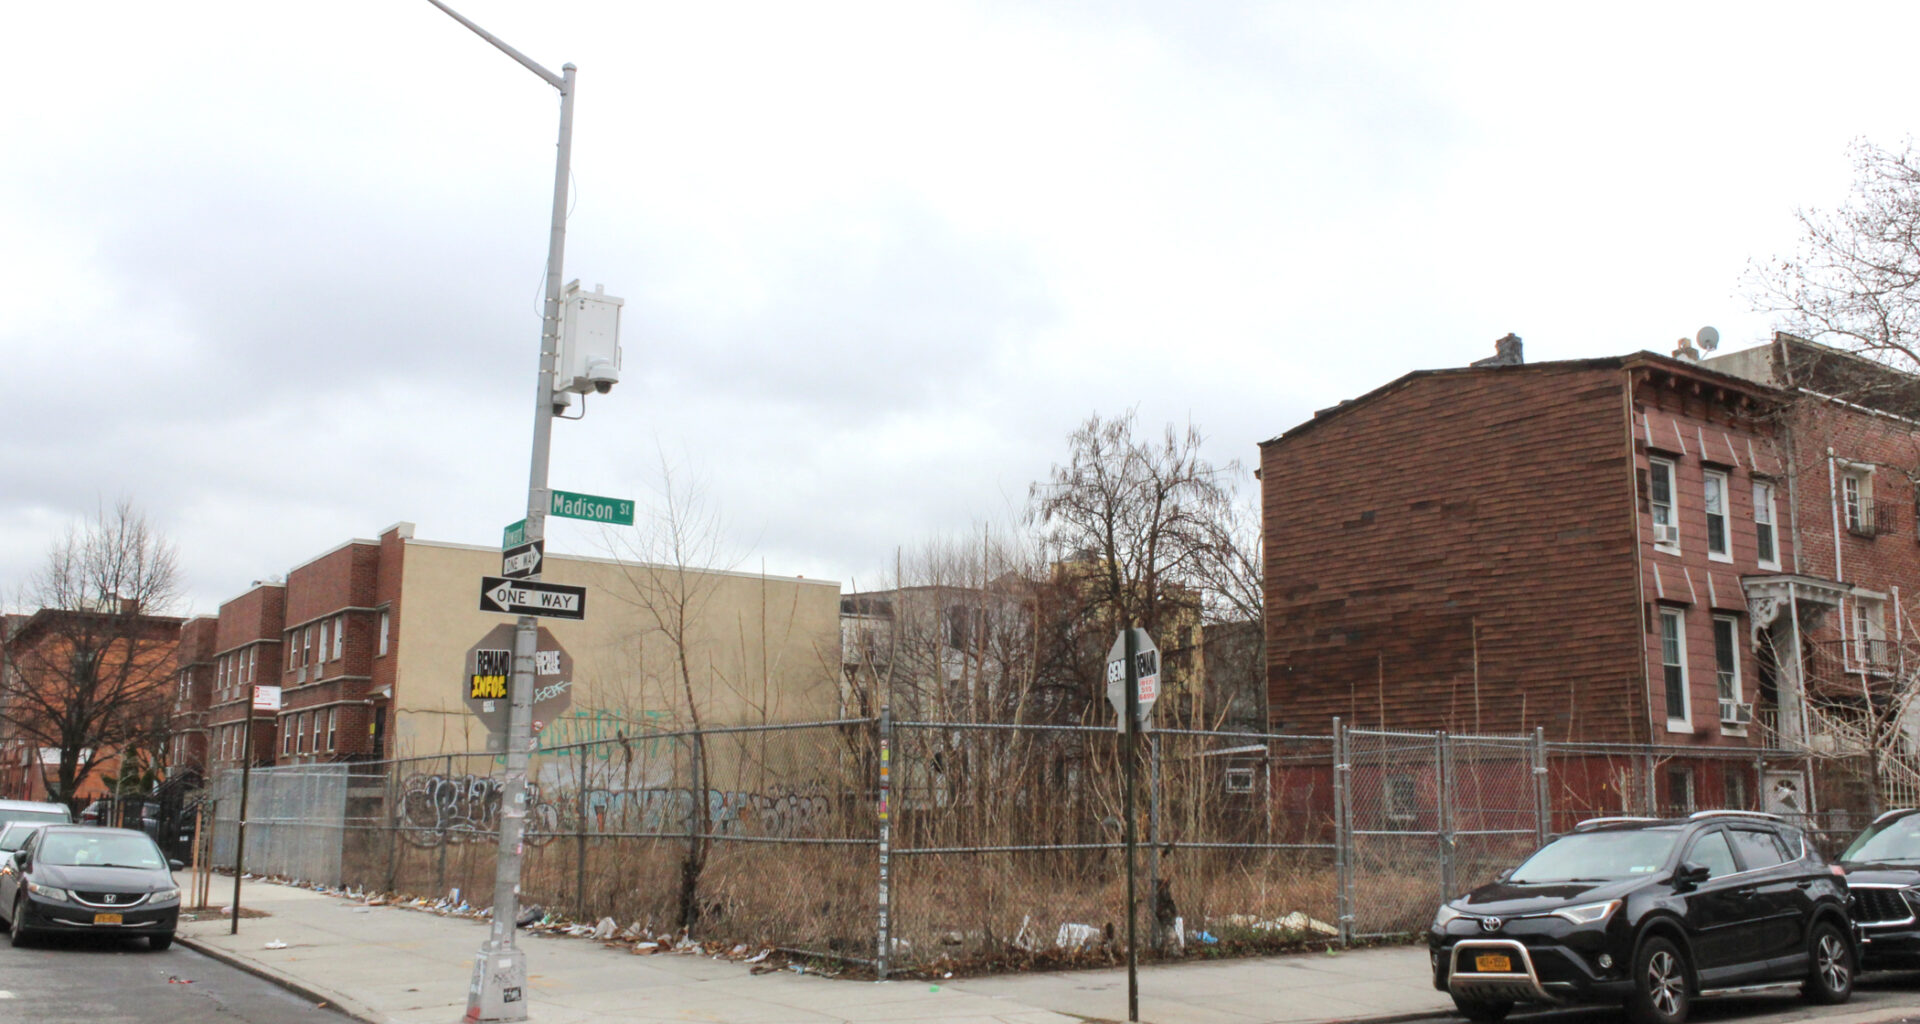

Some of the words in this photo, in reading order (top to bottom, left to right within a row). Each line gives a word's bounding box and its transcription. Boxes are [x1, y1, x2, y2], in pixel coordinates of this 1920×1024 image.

[553, 493, 613, 520] Madison
[619, 503, 630, 515] St
[506, 557, 519, 572] ONE
[522, 551, 537, 567] WAY
[497, 589, 526, 604] ONE
[541, 593, 572, 608] WAY
[477, 650, 510, 676] REMAND
